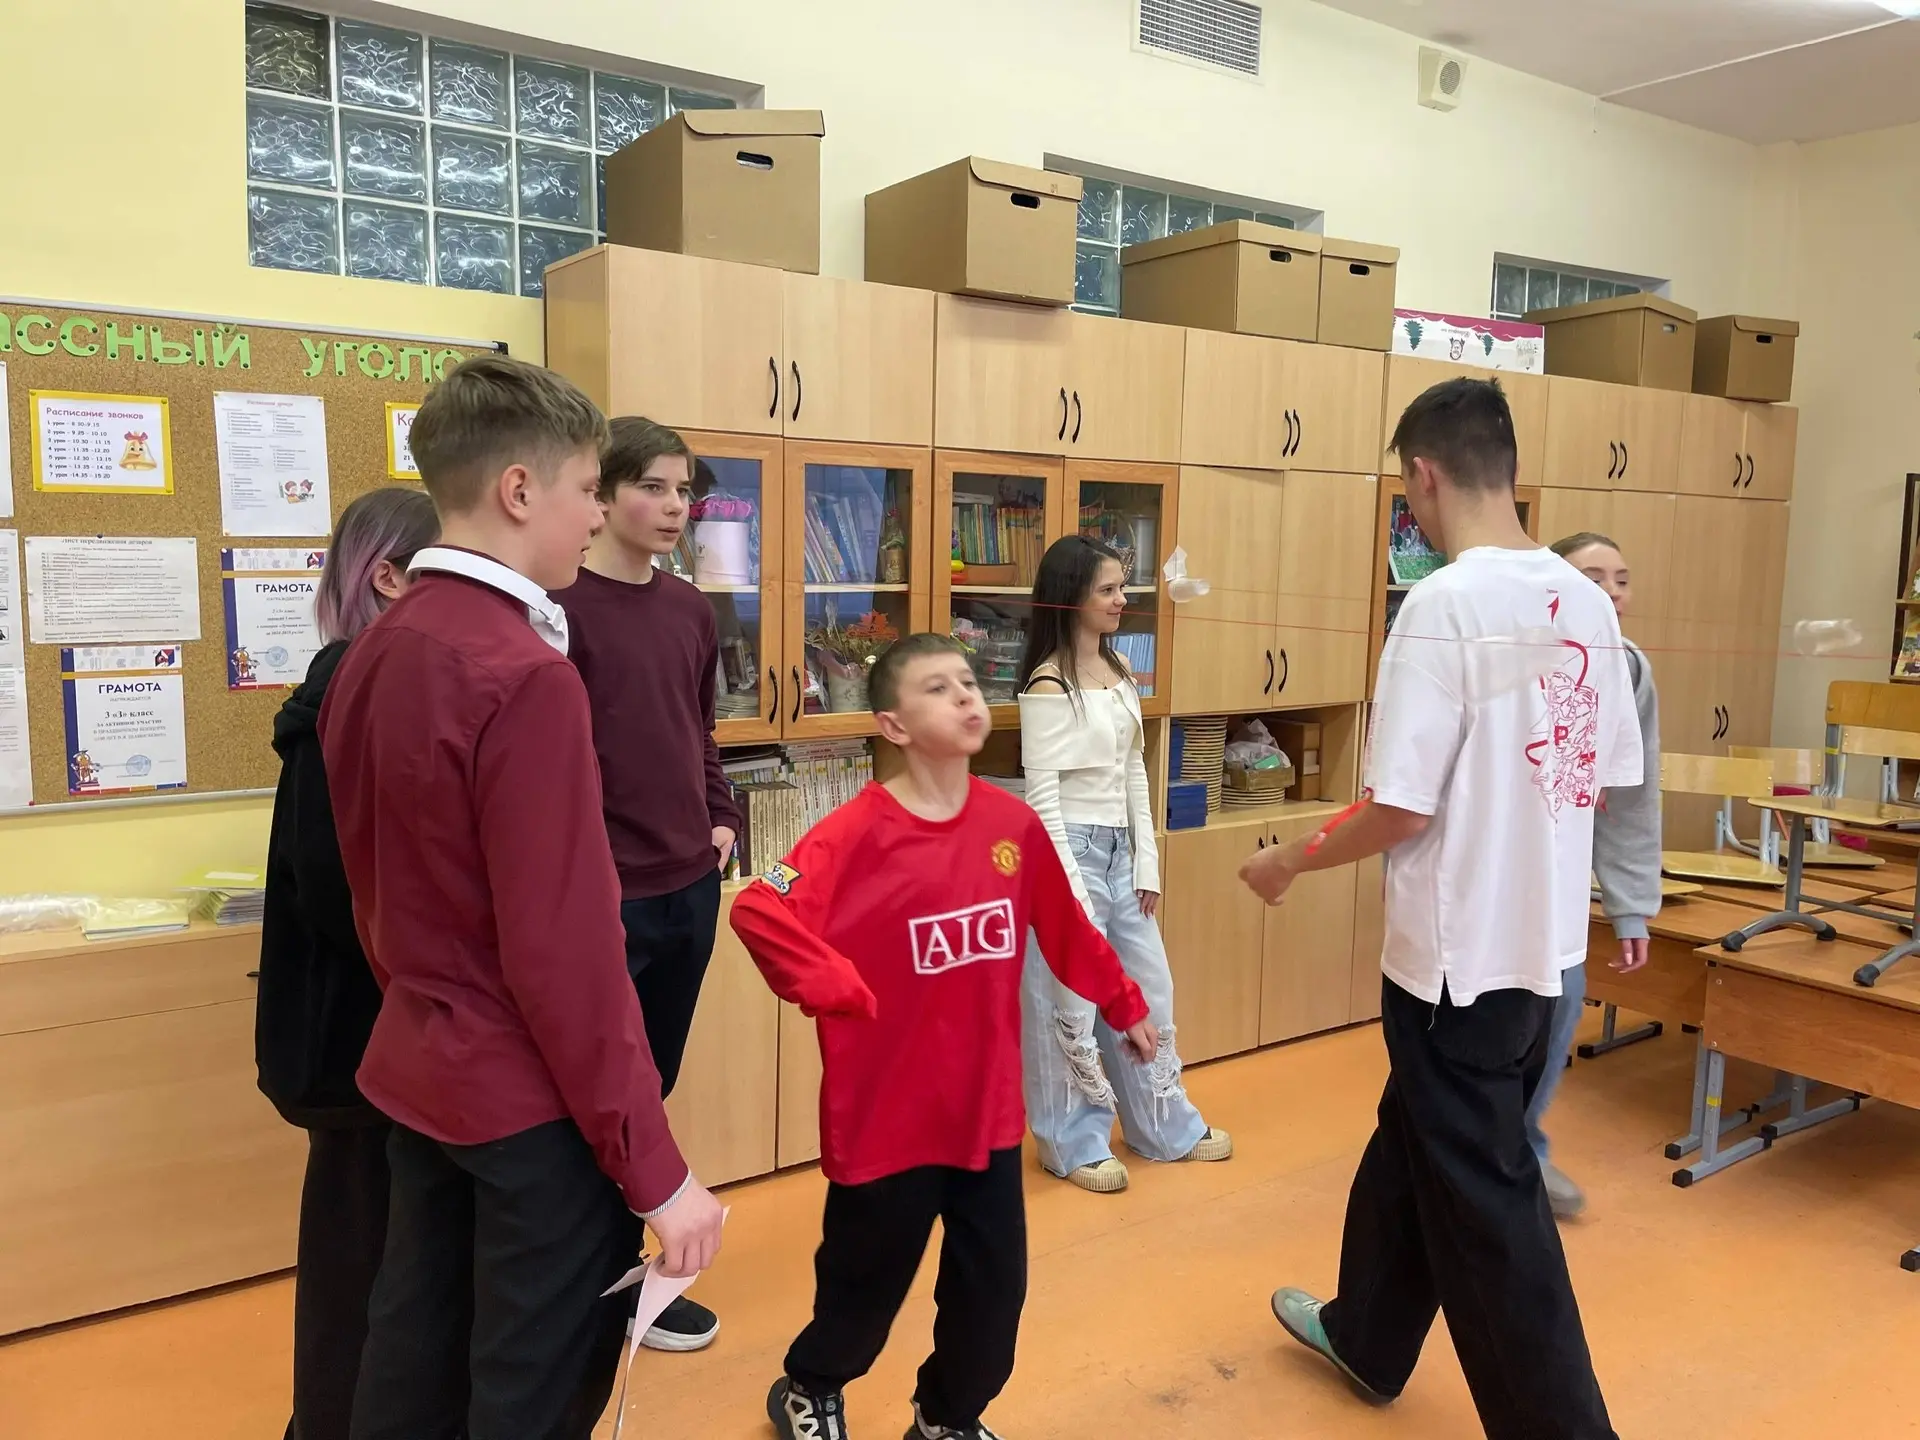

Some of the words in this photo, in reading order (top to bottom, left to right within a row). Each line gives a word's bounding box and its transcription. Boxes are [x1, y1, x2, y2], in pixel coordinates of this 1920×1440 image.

[300, 338, 468, 383] уголо
[46, 407, 104, 418] Расписание
[256, 583, 313, 593] ГРАМОТА
[98, 682, 162, 694] ГРАМОТА
[920, 906, 1013, 969] AIG
